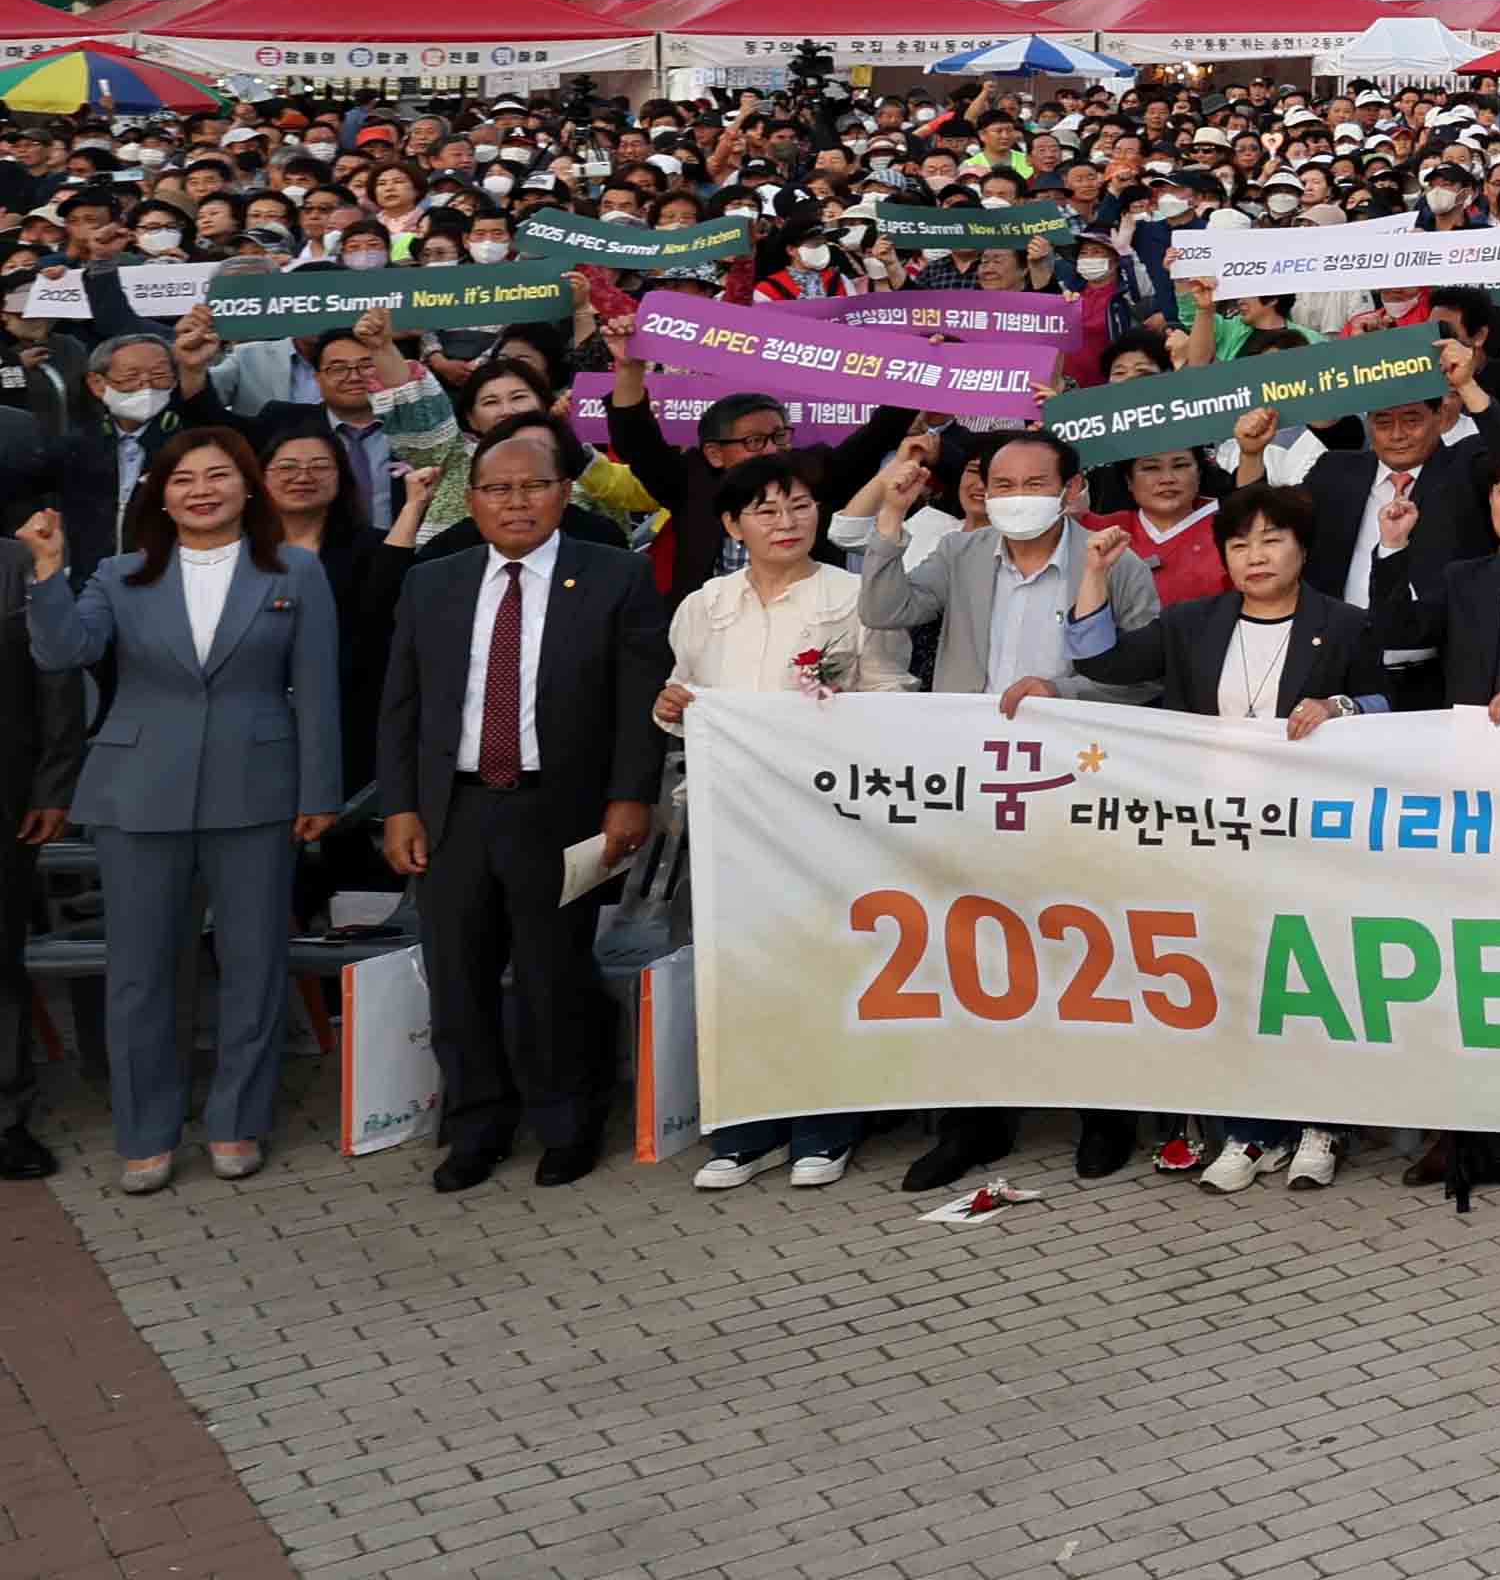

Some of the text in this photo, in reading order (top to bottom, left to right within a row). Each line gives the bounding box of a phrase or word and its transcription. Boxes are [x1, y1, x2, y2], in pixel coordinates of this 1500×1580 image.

[525, 221, 661, 257] 2025 APEC Summit
[917, 220, 966, 236] Summit
[1222, 246, 1443, 278] 2025 APEC 정상회의 이제는
[209, 281, 560, 318] 2025 APEC it's Incheon
[911, 306, 1070, 335] 인천 유치를 기원합니다.
[640, 312, 1034, 397] 2025 APEC 정상회의 인천 유치를 기원합니다.
[1050, 352, 1432, 443] 2025 APEC Summit Now, it's Incheon
[812, 740, 1494, 855] 인천의 꿈 대한민국의 미래
[849, 888, 1221, 1032] 2025
